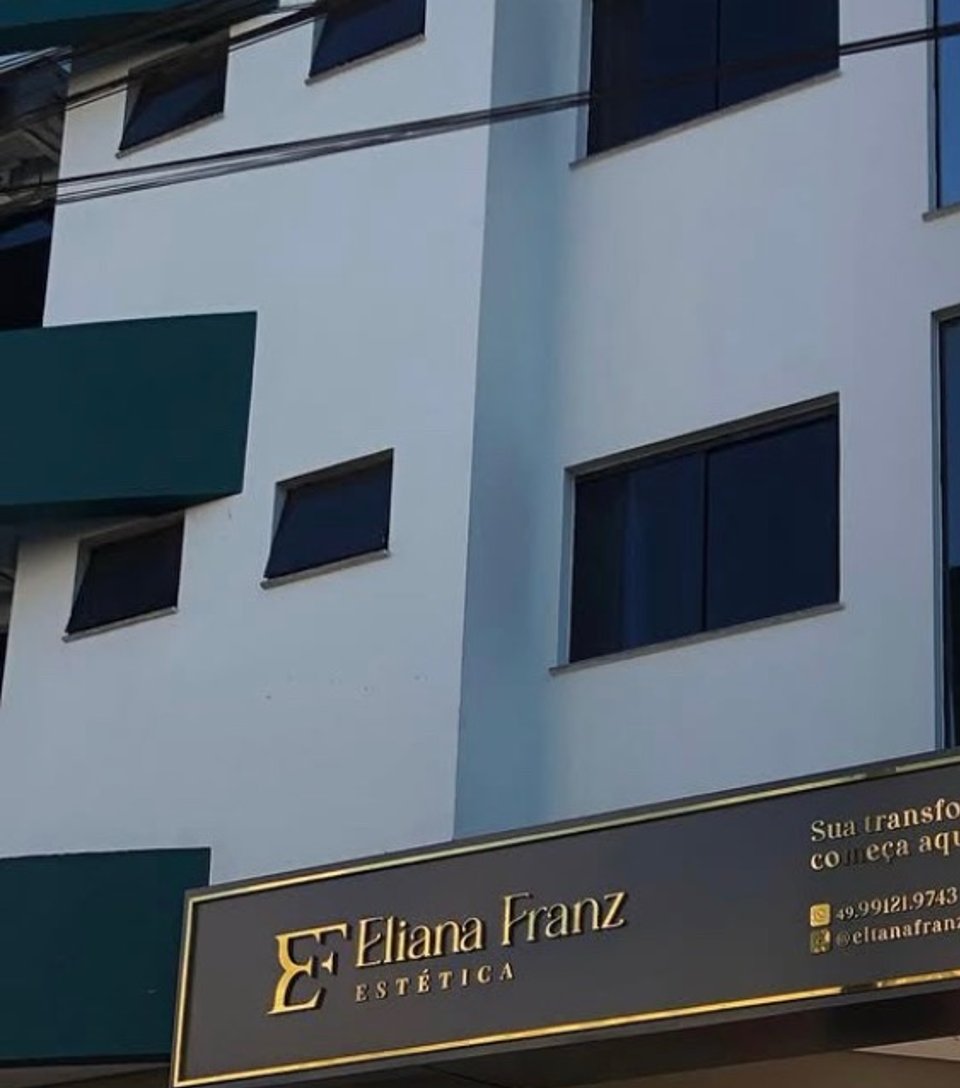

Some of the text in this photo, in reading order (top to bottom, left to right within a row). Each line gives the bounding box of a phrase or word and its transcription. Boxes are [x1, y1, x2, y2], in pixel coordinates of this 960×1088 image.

[811, 819, 857, 842] Sua
[836, 886, 959, 921] 49.99121.9743
[355, 891, 628, 969] Eliana Franz
[355, 961, 514, 1003] ESTÉTICA
